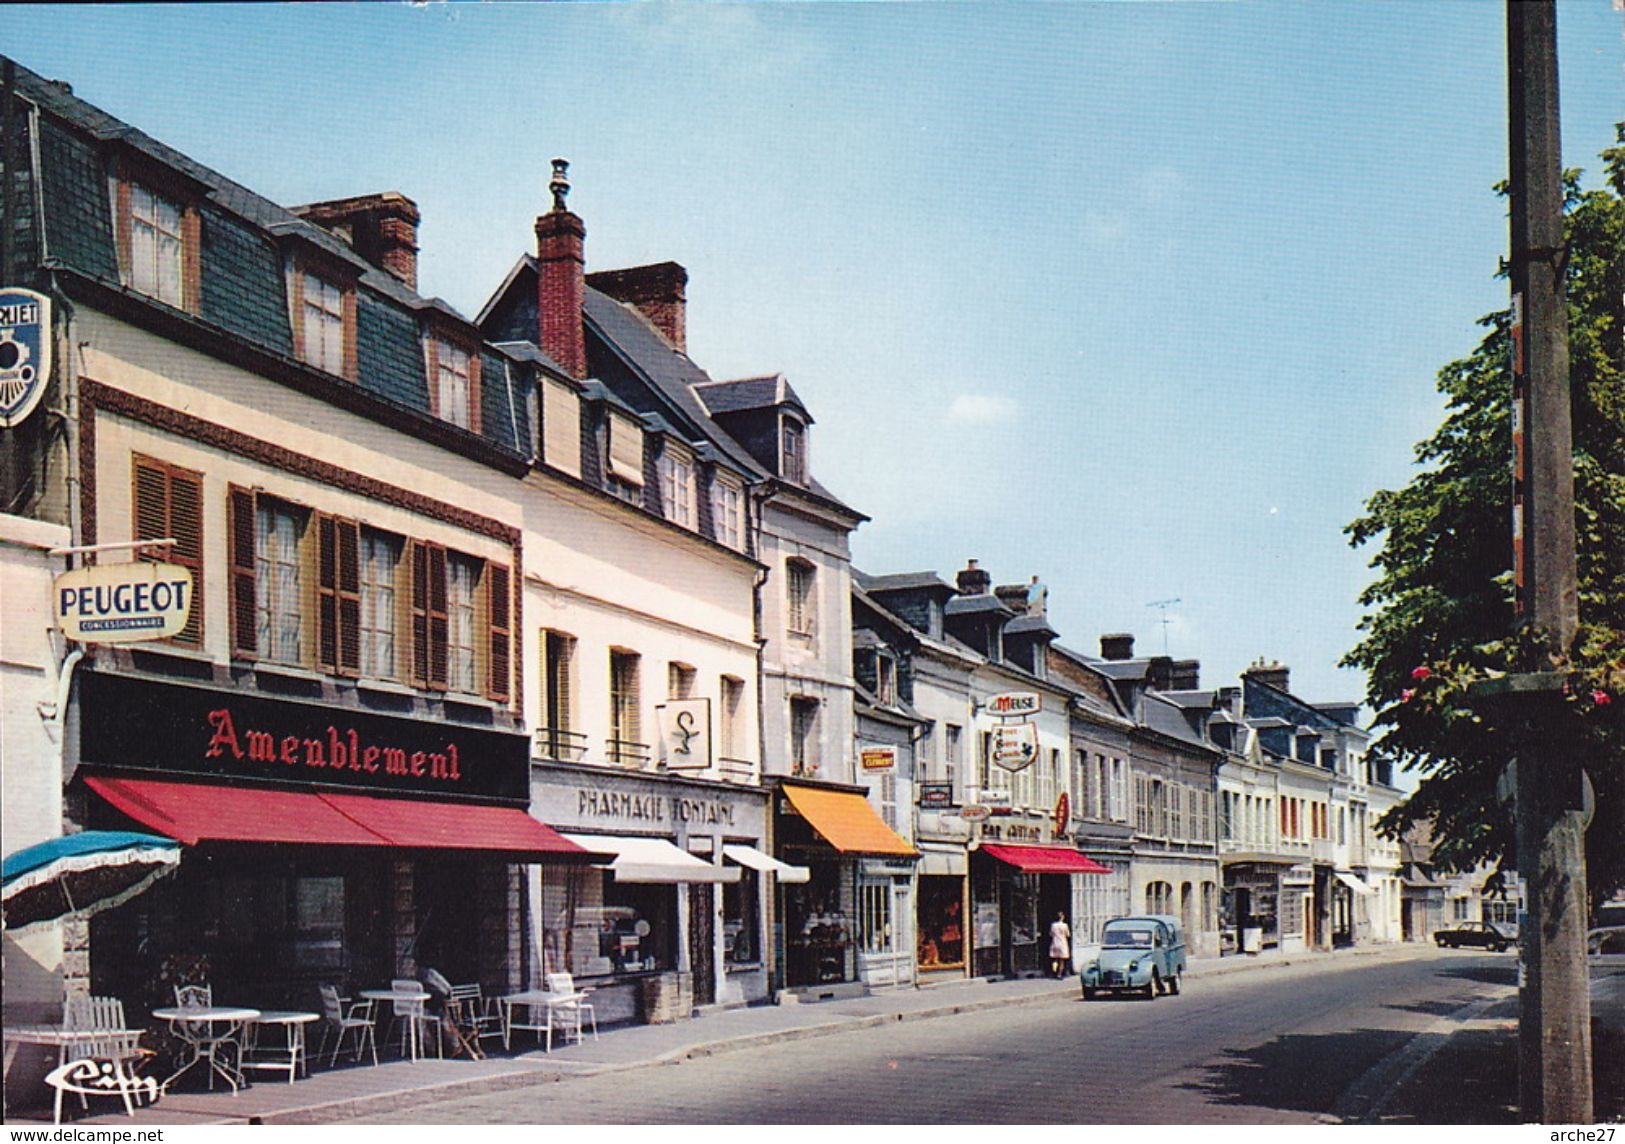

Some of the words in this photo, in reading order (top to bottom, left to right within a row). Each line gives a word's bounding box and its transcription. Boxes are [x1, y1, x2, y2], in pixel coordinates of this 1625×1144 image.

[60, 581, 188, 616] PEUGEOT
[81, 617, 163, 630] CONCESSIONNAIRE
[205, 708, 461, 780] Ameublement
[578, 789, 663, 822] PHARMACIE
[673, 794, 735, 827] FONTAINE
